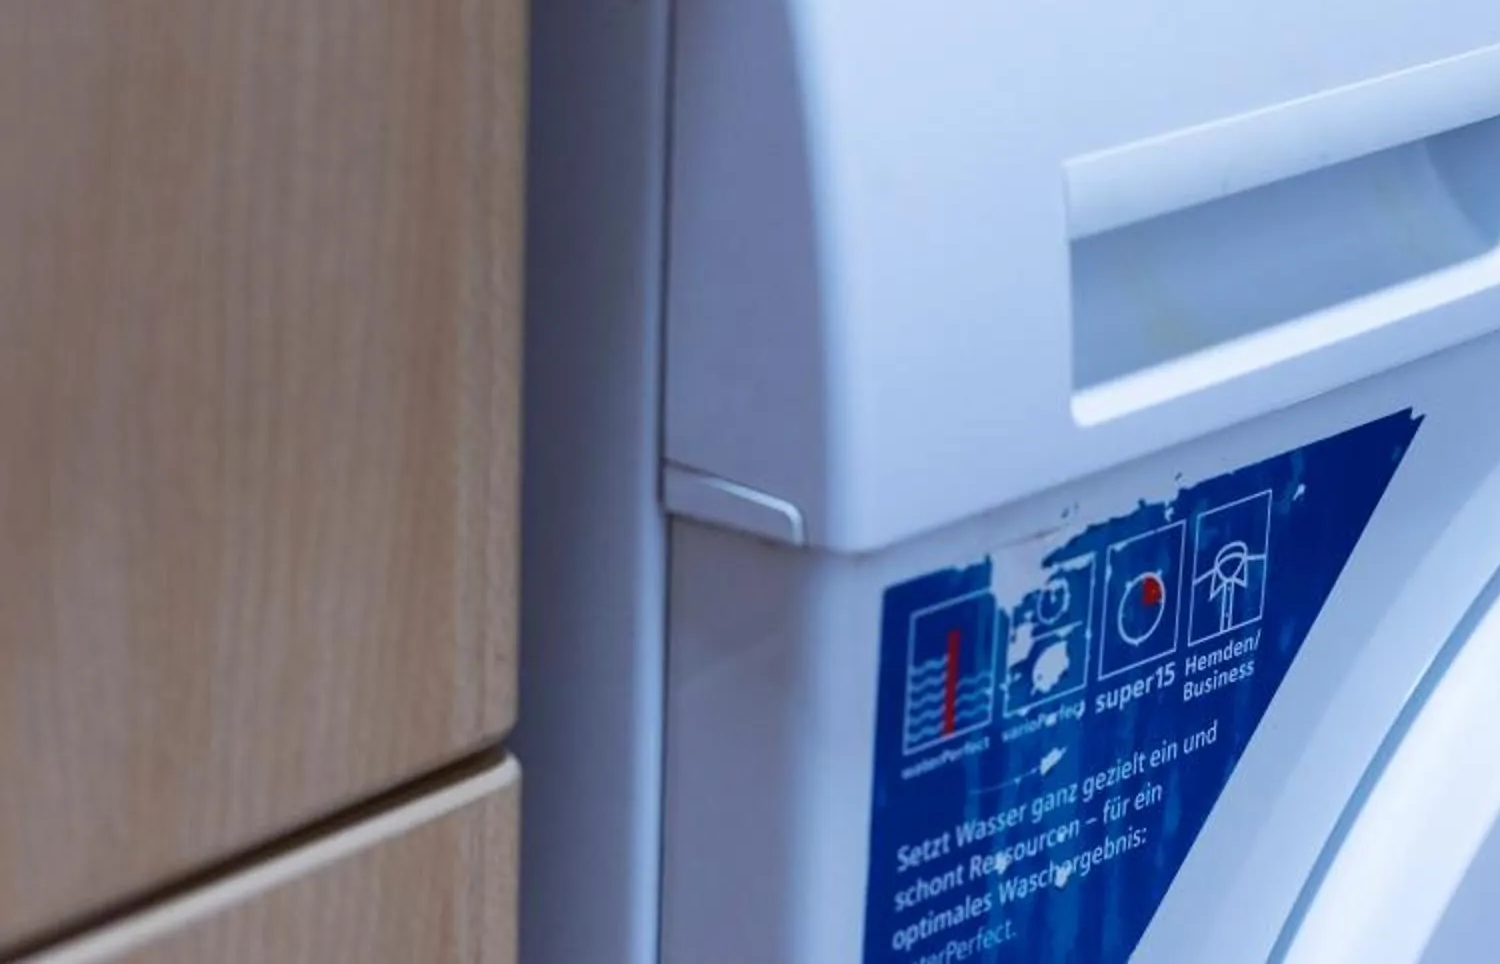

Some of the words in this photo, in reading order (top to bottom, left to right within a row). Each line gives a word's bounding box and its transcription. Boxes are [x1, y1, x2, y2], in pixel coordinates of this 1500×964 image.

[1185, 628, 1262, 676] Hemden/
[1095, 661, 1176, 714] super15
[1183, 661, 1255, 702] Business
[897, 831, 950, 873] Setzt
[955, 803, 1026, 848] Wasser
[1031, 783, 1078, 824] ganz
[1082, 751, 1146, 803] gezielt
[1150, 740, 1178, 768] ein
[1183, 719, 1218, 754] und
[894, 864, 964, 912] schont
[969, 818, 1080, 881] Resourcen
[1103, 796, 1130, 825] für
[1134, 783, 1163, 812] ein
[891, 895, 992, 951] optimales
